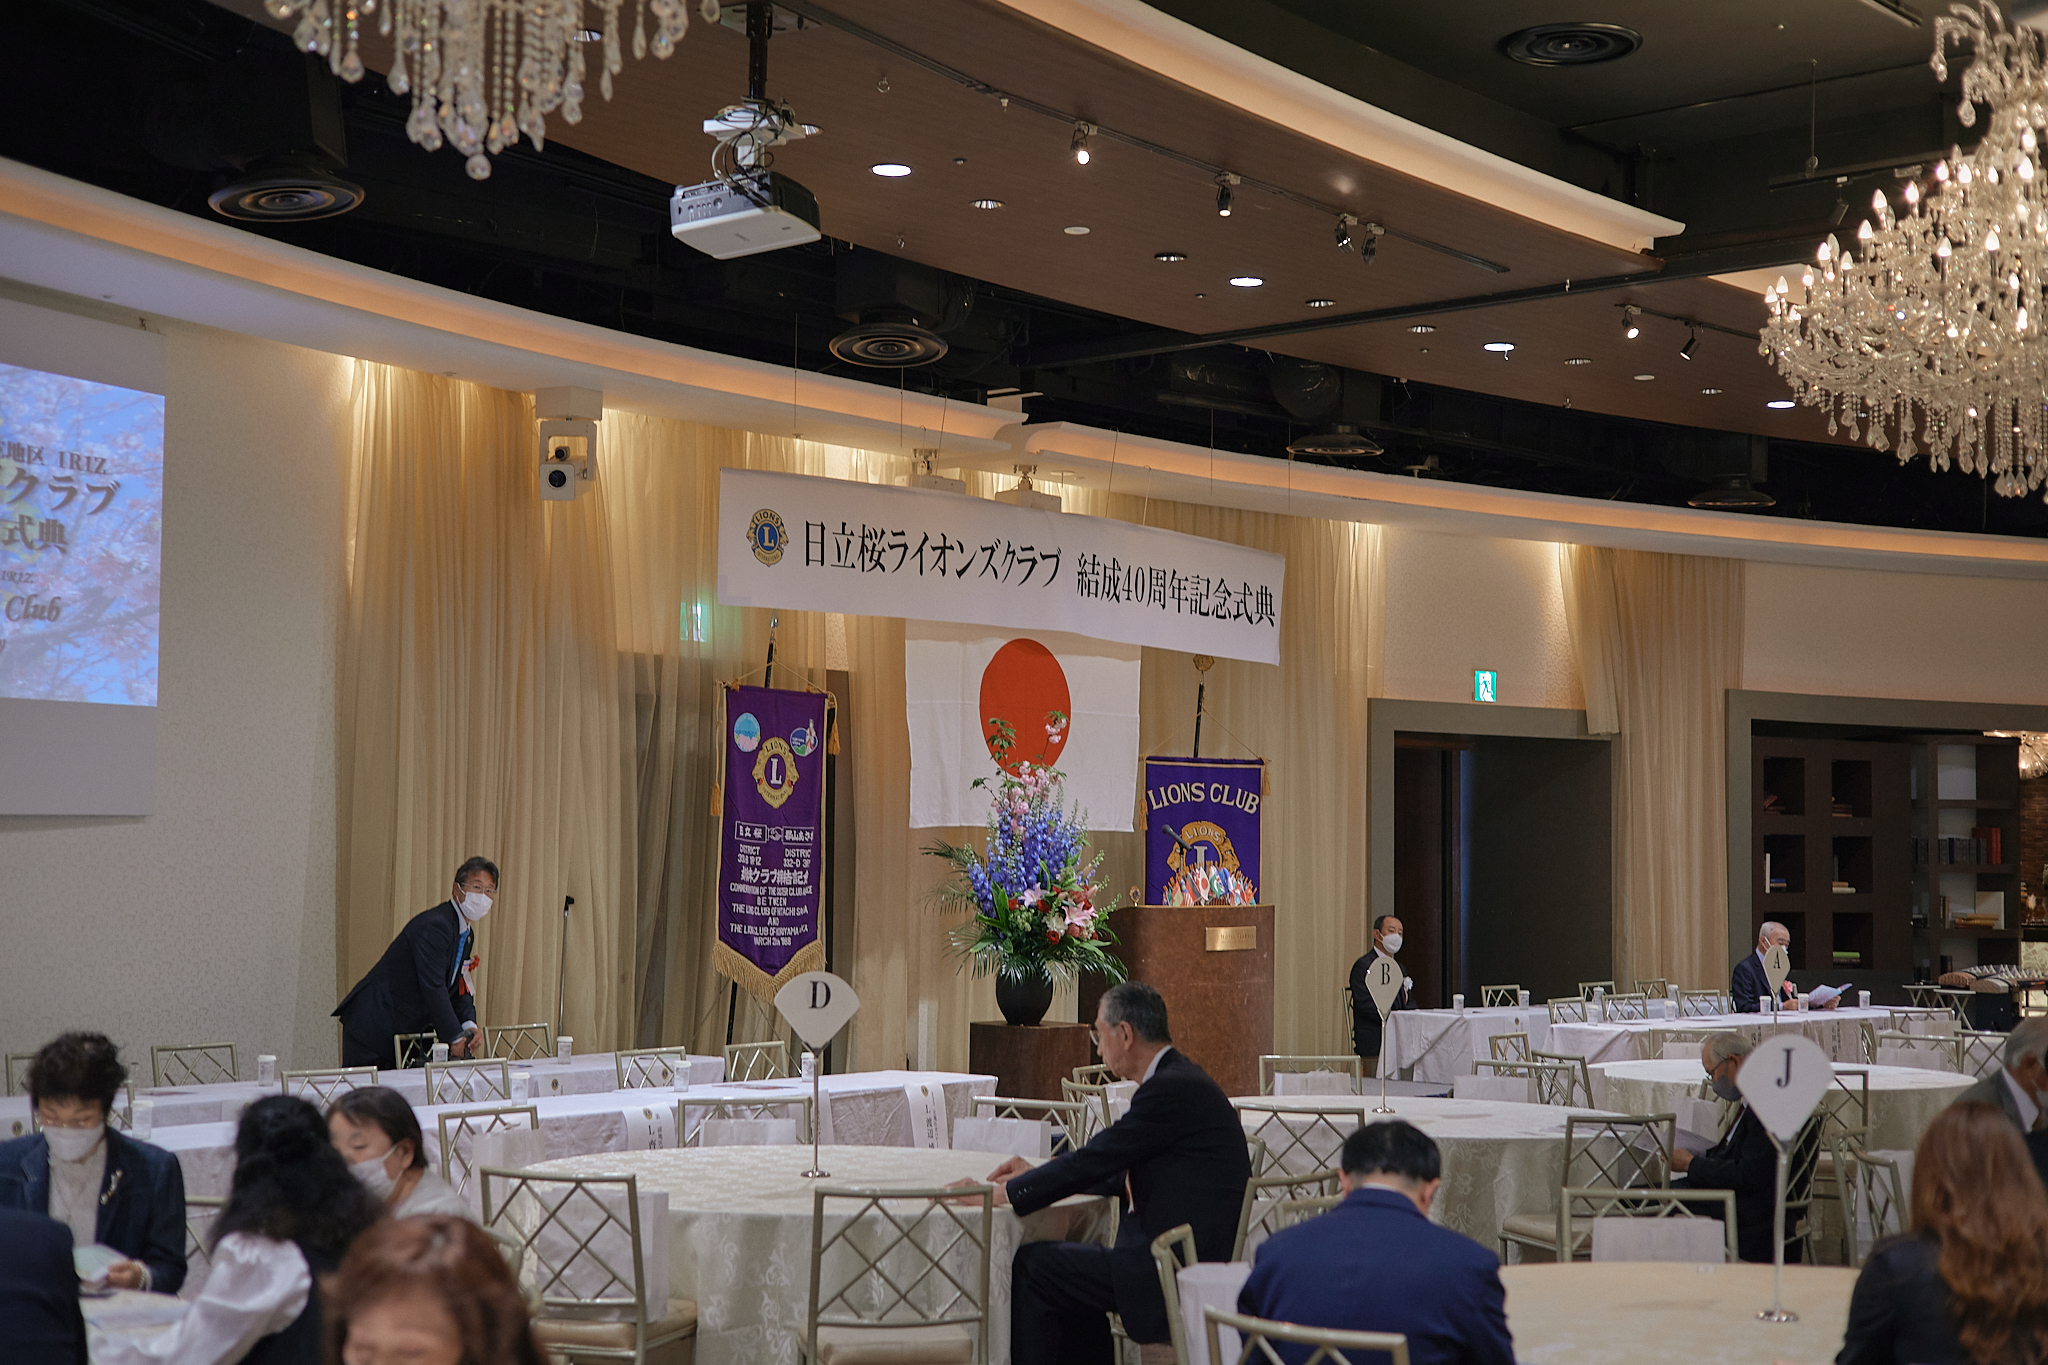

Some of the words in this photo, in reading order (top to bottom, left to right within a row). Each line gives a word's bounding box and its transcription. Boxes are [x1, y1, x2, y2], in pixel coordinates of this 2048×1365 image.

[755, 511, 780, 525] LIONS
[1, 514, 68, 555] 式典
[763, 526, 775, 547] L
[805, 519, 1063, 588] 日立桜ライオンズクラブ
[1077, 551, 1275, 628] 結成40周年記念式典
[5, 593, 62, 622] Club
[764, 741, 788, 756] LIONS
[770, 758, 782, 785] L
[1147, 782, 1206, 811] LIONS
[1210, 782, 1260, 815] CLUB
[1185, 826, 1221, 842] LIONS
[732, 902, 746, 914] THE
[730, 922, 743, 934] THE
[1773, 951, 1781, 969] A
[1380, 962, 1391, 986] B
[808, 980, 832, 1010] D
[1776, 1048, 1796, 1089] J
